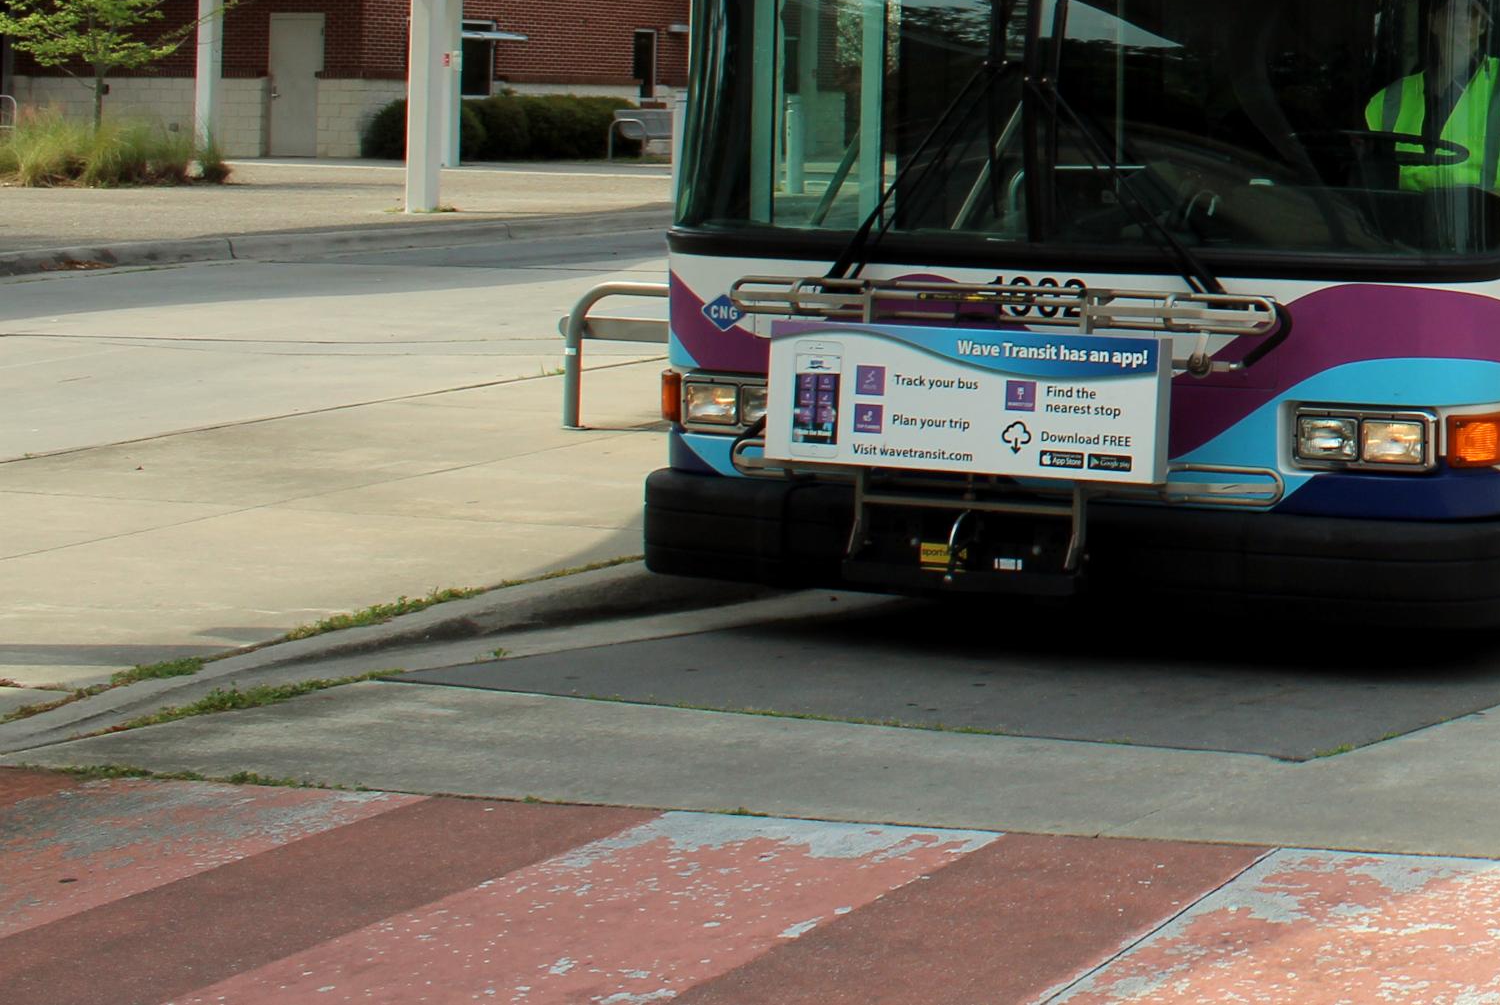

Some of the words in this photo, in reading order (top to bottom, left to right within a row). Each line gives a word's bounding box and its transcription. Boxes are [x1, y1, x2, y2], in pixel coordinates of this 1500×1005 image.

[710, 305, 738, 320] CNG
[956, 339, 1000, 357] Wave
[1002, 342, 1058, 360] Transit
[1059, 345, 1087, 362] has
[1089, 349, 1110, 363] an
[1112, 349, 1149, 368] app!
[893, 374, 926, 387] Track
[928, 378, 955, 390] your
[957, 377, 980, 390] bus
[1046, 386, 1073, 399] Find
[1075, 387, 1097, 400] the
[1045, 403, 1092, 415] nearest
[1094, 405, 1122, 420] stop
[892, 414, 918, 427] Plan
[919, 417, 947, 430] your
[948, 416, 971, 432] trip
[1041, 430, 1100, 446] Download
[1102, 435, 1132, 447] FREE
[852, 444, 878, 456] Visit
[879, 446, 974, 462] wavetransit.com
[1051, 457, 1066, 467] App
[1066, 457, 1082, 467] Store
